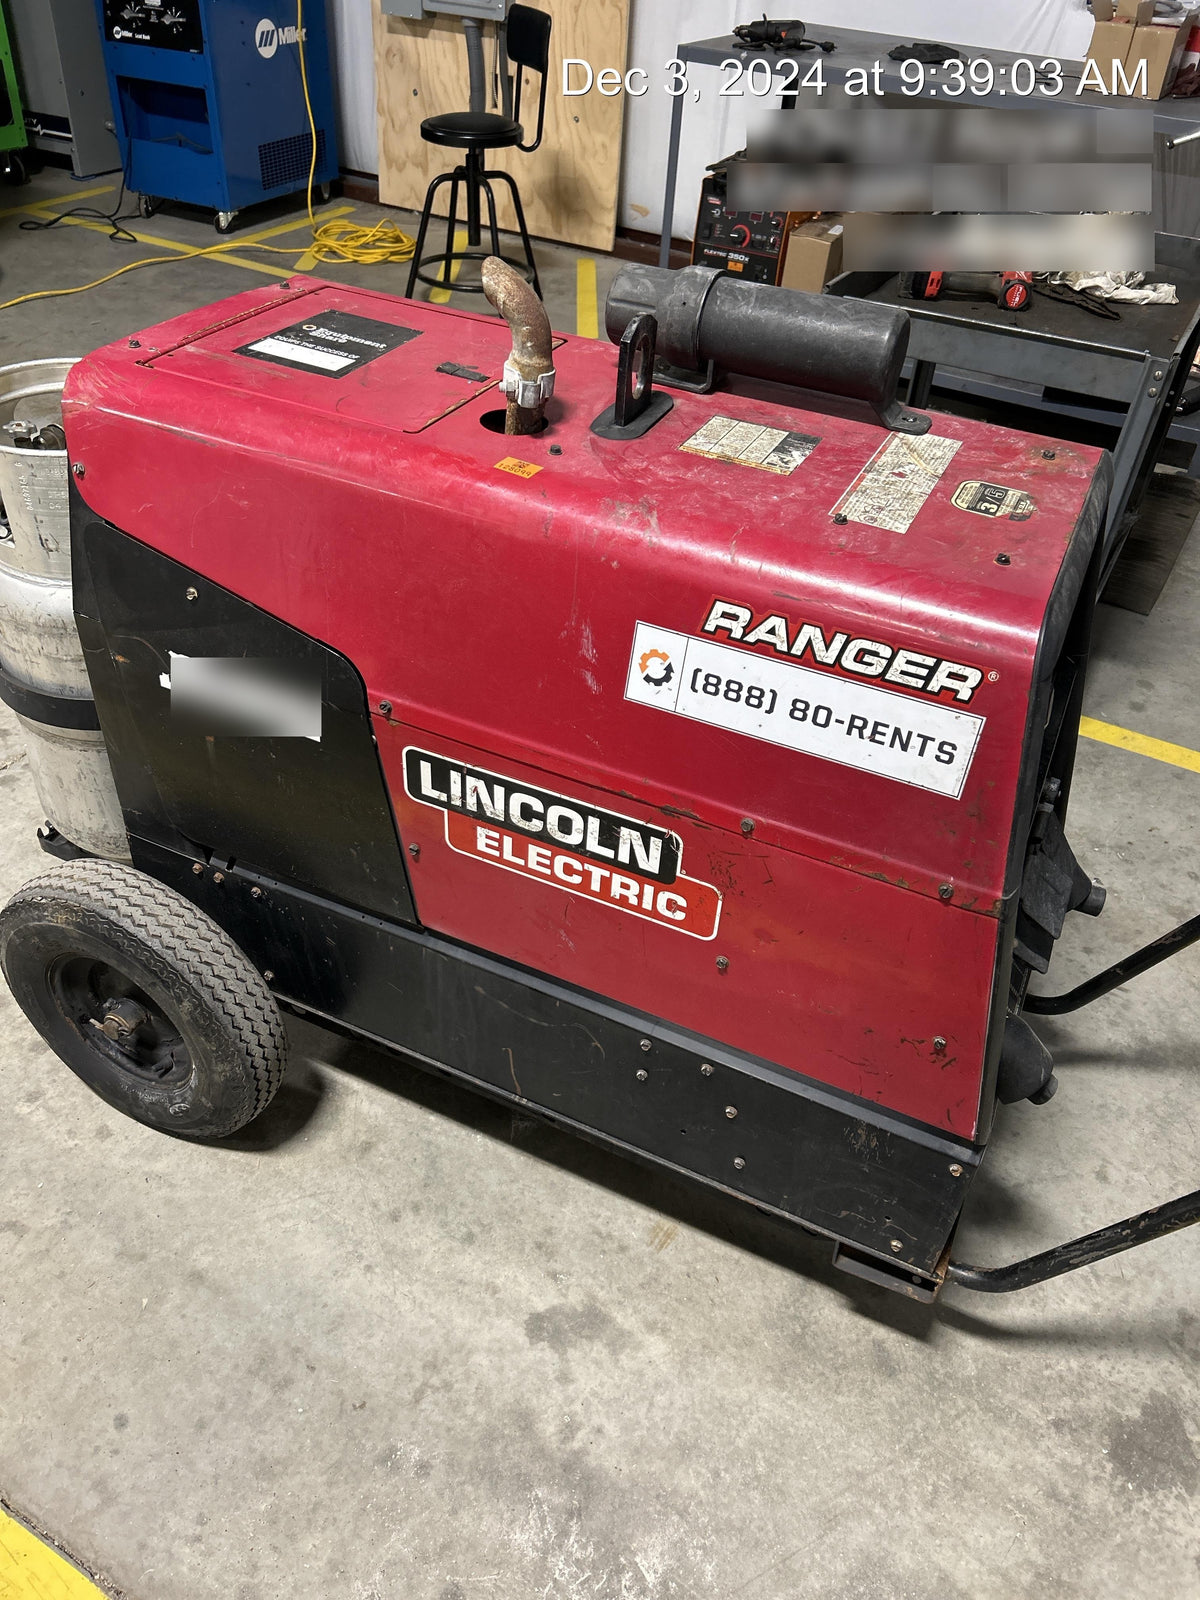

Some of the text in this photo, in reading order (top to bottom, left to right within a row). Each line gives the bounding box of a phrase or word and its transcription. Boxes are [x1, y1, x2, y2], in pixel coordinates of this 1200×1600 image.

[301, 341, 315, 349] THE
[315, 345, 348, 357] SUCCESS
[309, 331, 348, 344] Share
[318, 327, 387, 349] Equipment
[702, 599, 982, 702] RANGER
[689, 667, 959, 767] (888) 80-RENTS
[419, 759, 662, 875] LINCOLN
[475, 826, 688, 921] ELECTRIC
